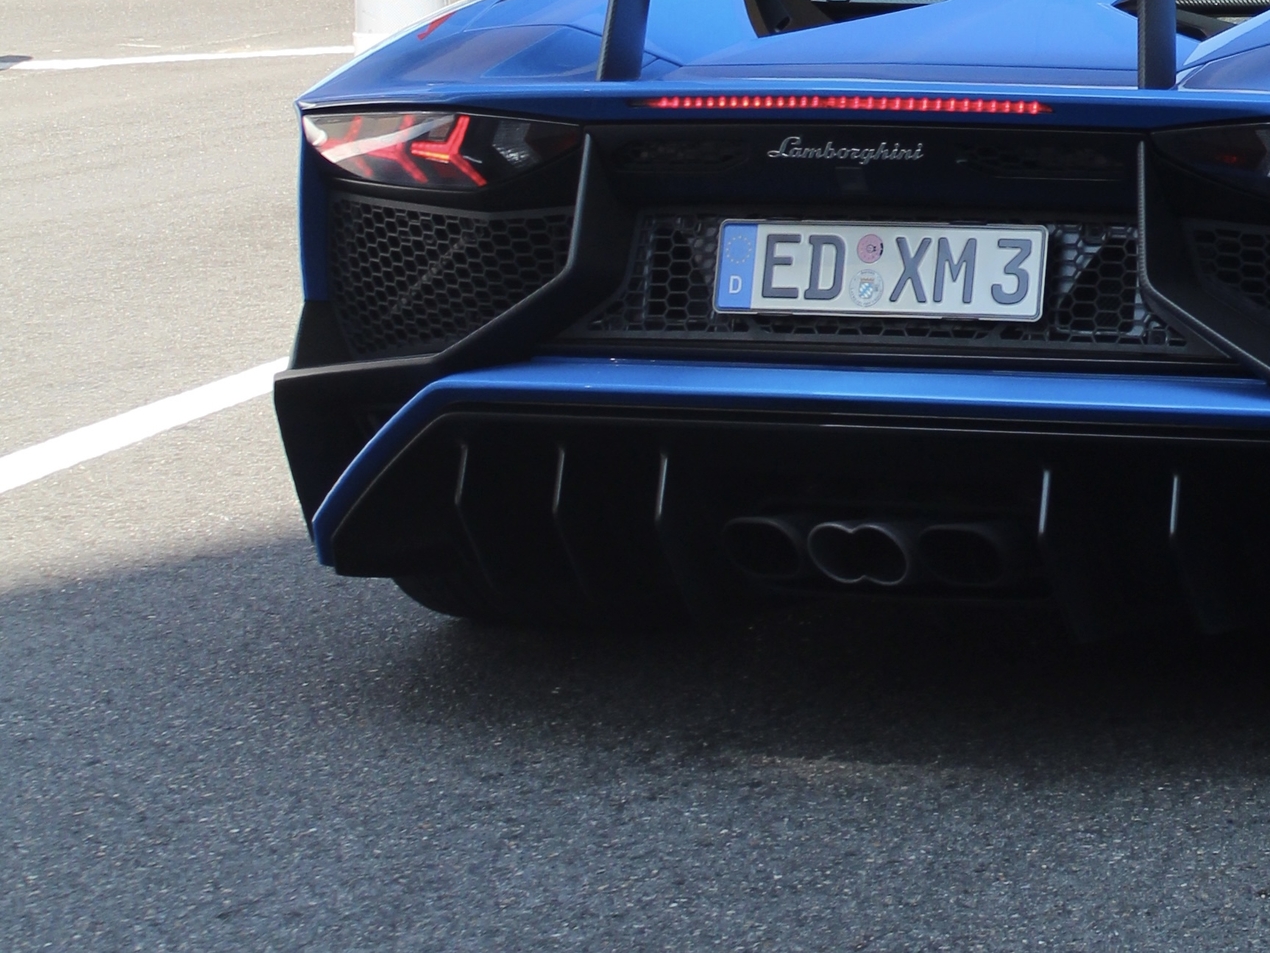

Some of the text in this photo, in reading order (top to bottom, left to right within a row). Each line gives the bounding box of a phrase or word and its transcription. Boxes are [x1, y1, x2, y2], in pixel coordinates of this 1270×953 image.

[767, 136, 924, 164] Lamborghini
[761, 234, 847, 300] ED
[889, 237, 978, 303] XM
[991, 238, 1033, 305] 3
[729, 275, 743, 294] D
